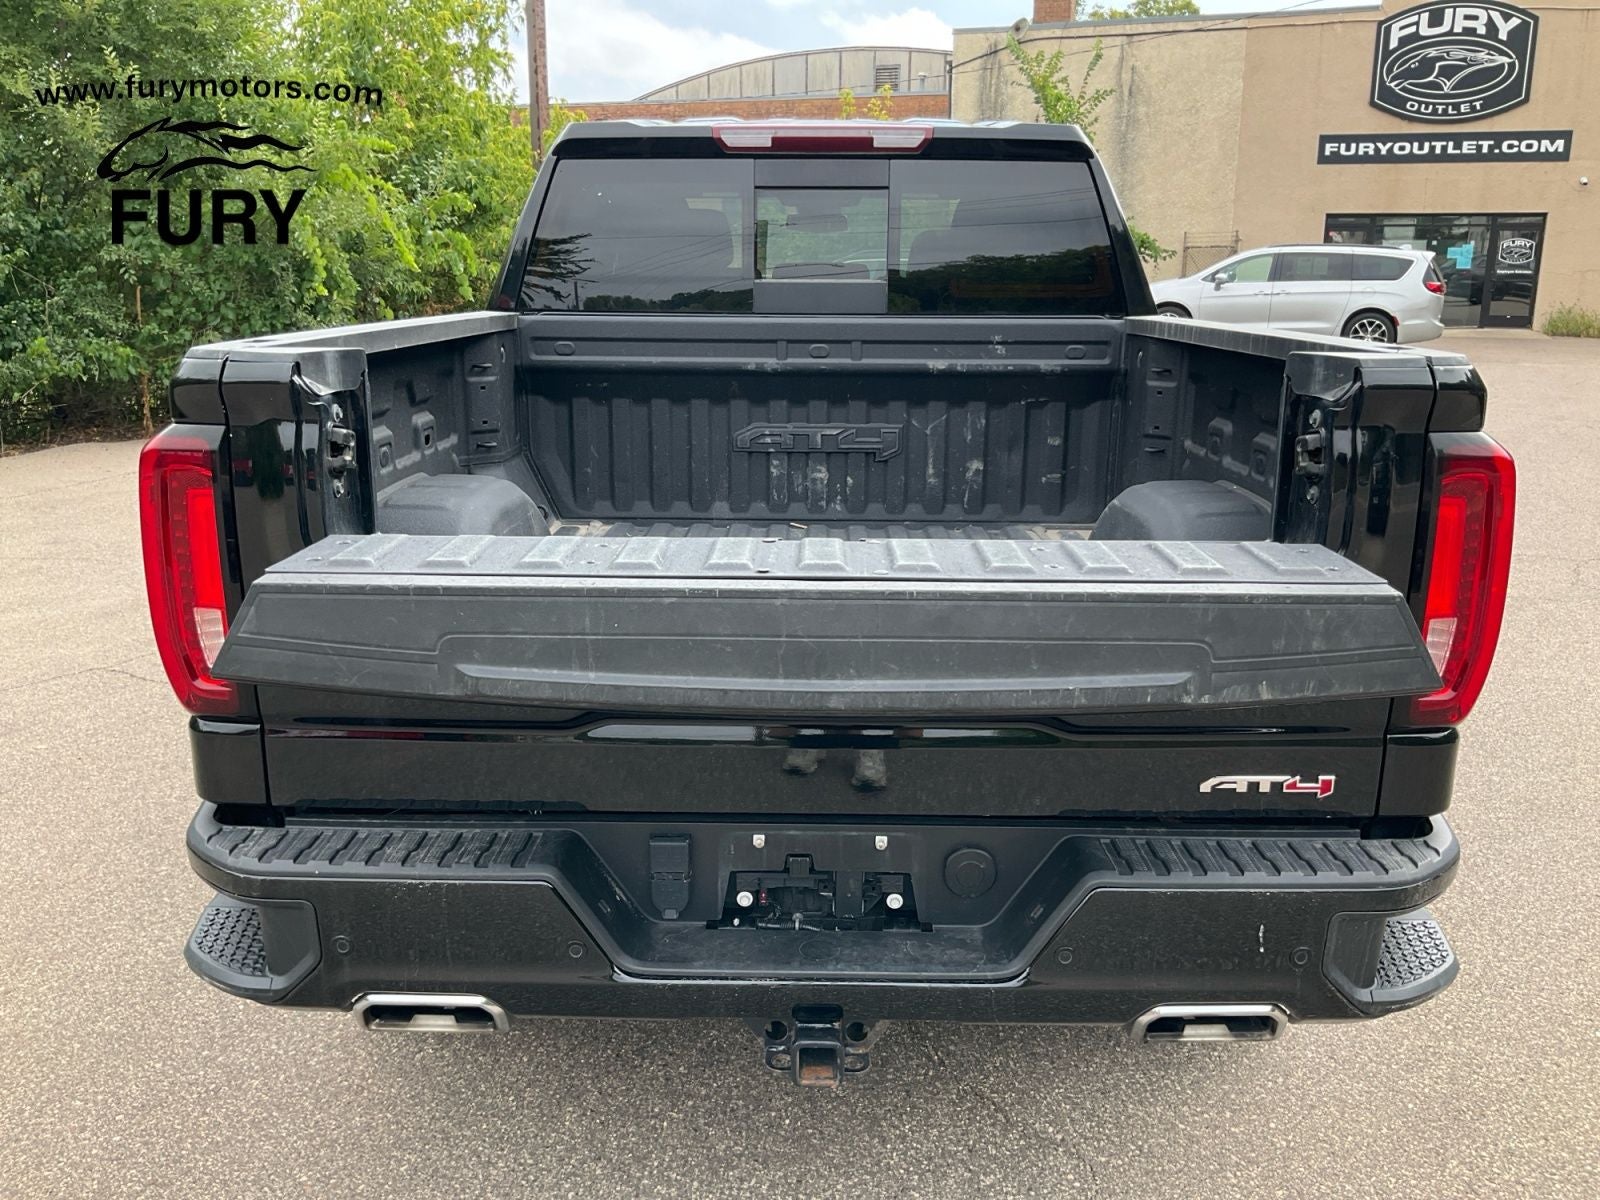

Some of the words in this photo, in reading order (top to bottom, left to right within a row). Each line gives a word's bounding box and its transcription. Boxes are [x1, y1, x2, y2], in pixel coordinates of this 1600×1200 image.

[1389, 7, 1522, 50] FURY
[1406, 100, 1484, 115] OUTLET
[1324, 139, 1565, 156] FURYOUTLET.COM
[1503, 240, 1532, 249] FURY
[734, 424, 902, 461] AT4
[1199, 775, 1336, 798] AT4
